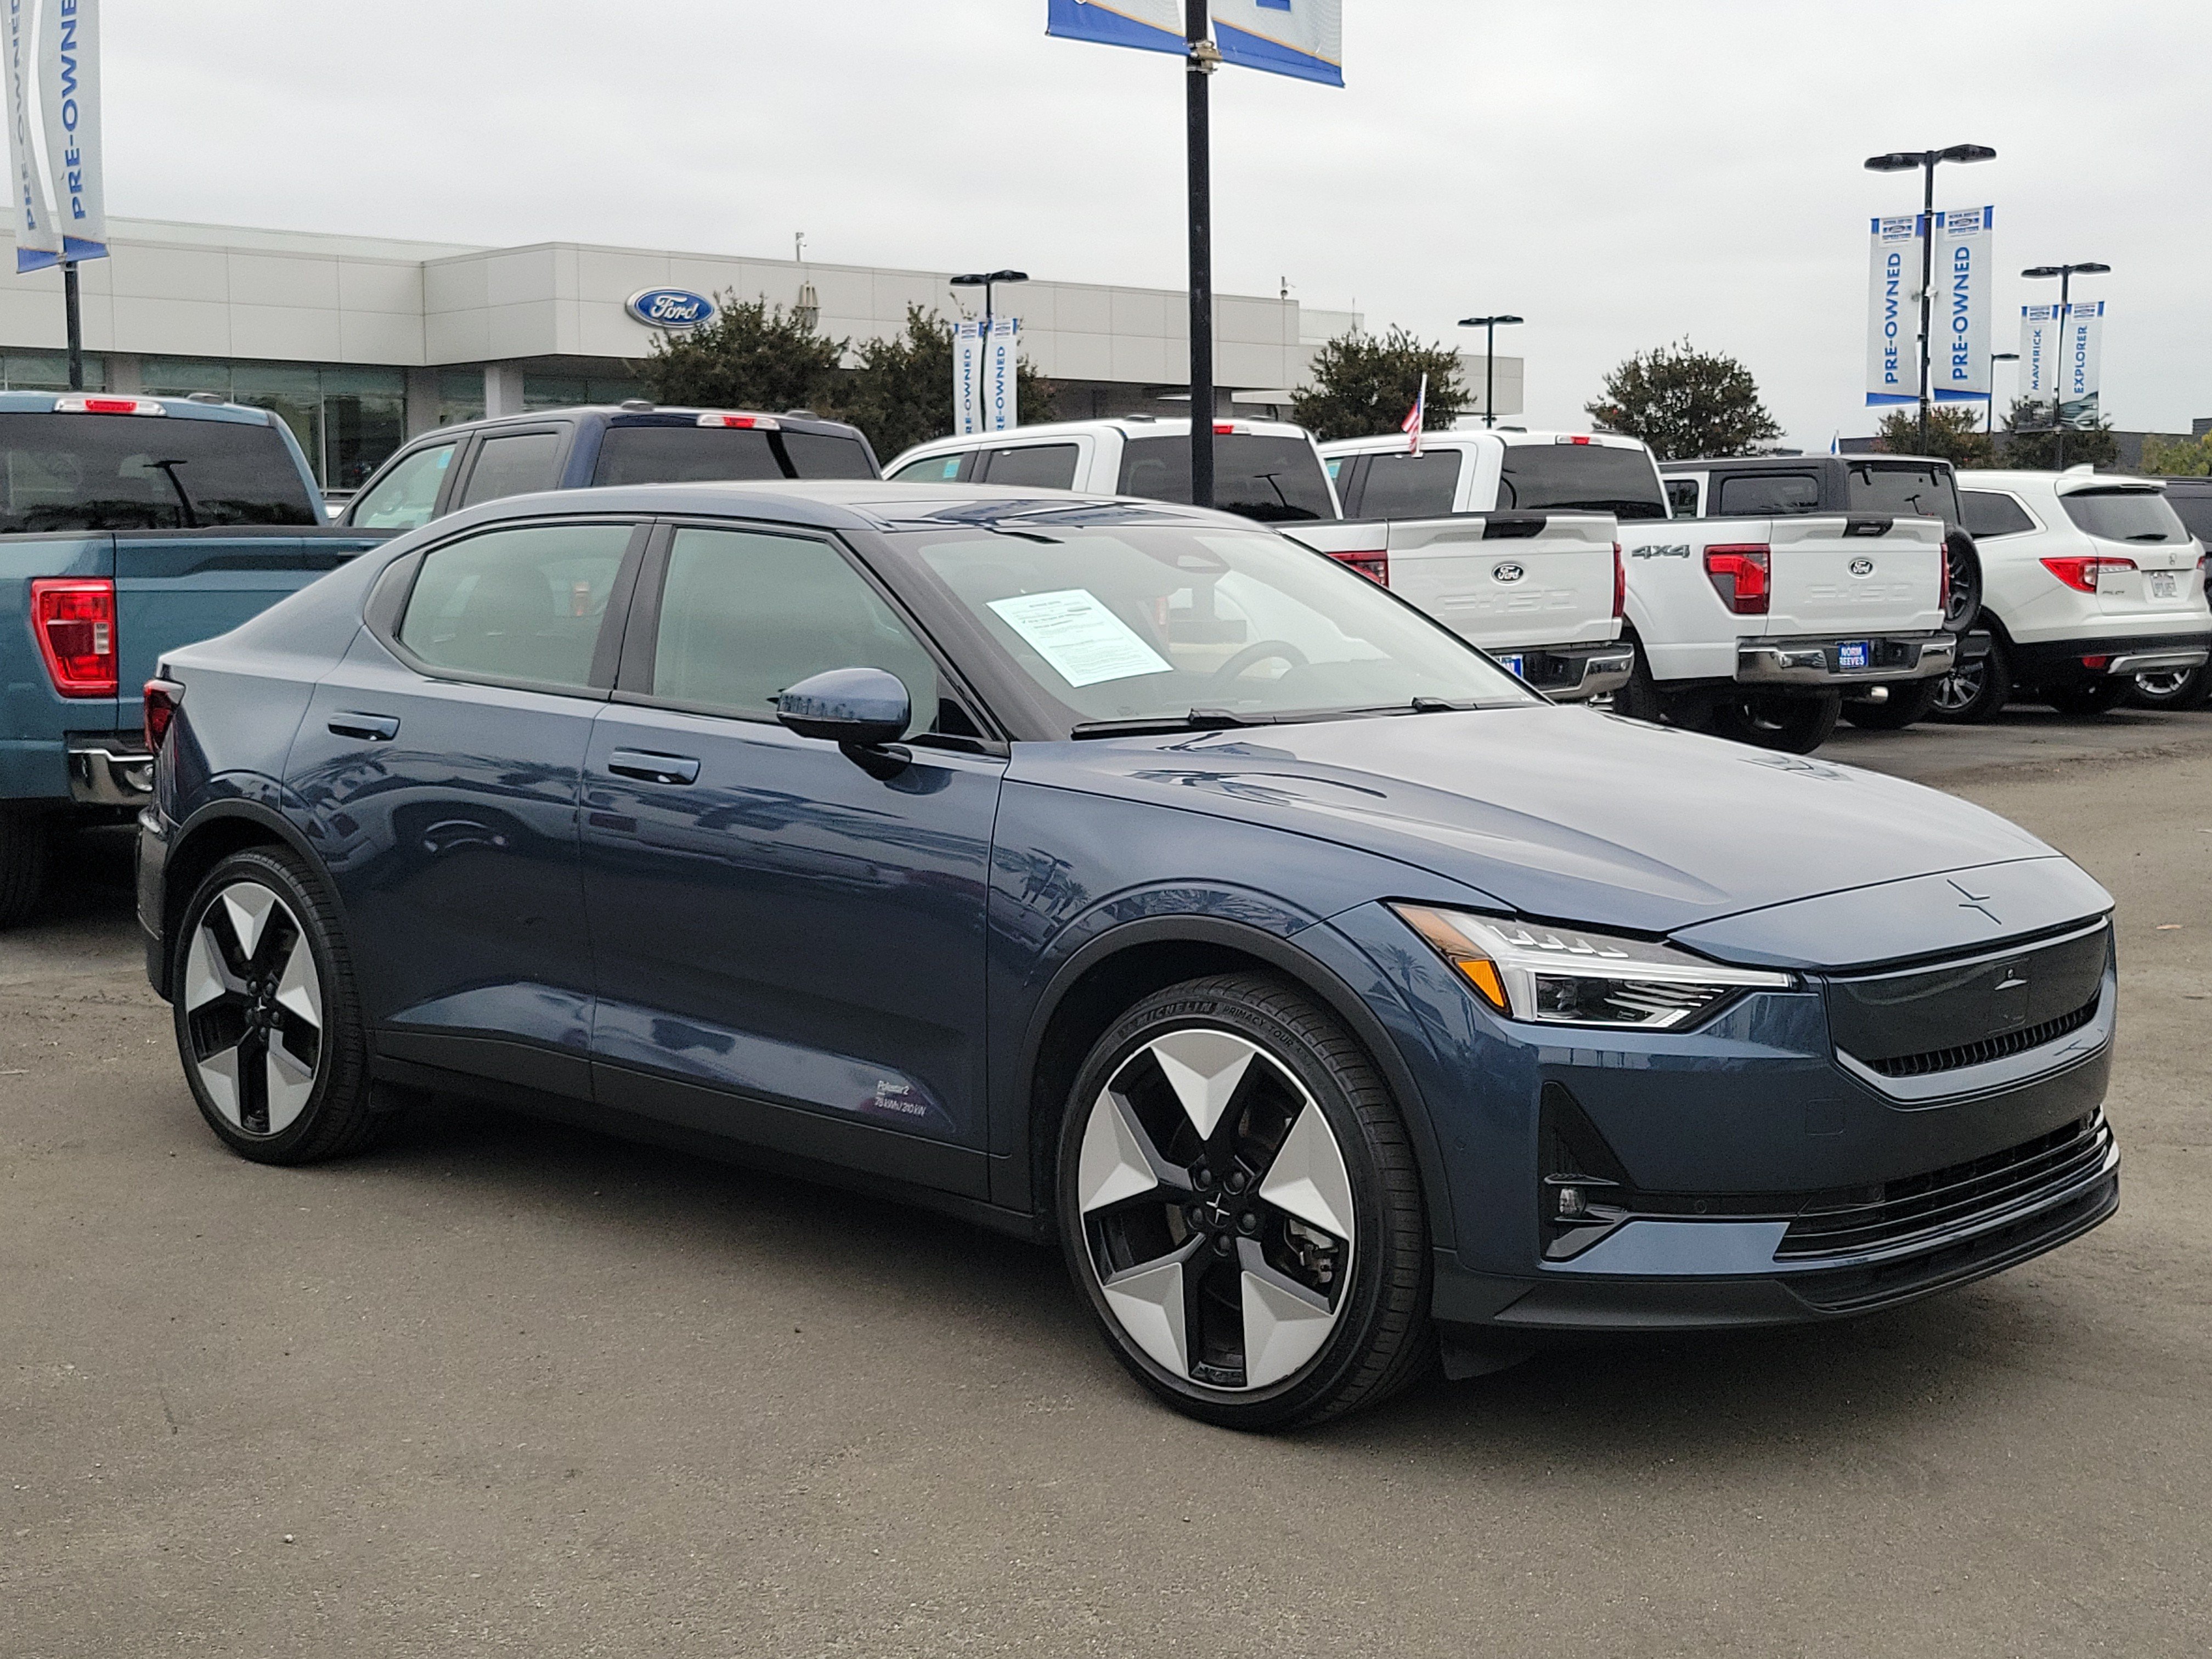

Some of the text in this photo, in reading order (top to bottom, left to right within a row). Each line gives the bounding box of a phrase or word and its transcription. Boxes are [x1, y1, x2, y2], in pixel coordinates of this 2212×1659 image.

[61, 0, 86, 220] PRE-OWNE
[650, 295, 699, 319] Ford
[1884, 253, 1901, 384] PRE-OWNED
[1953, 246, 1970, 380] PRE-OWNED
[2032, 329, 2041, 390] MAVERICK
[2074, 325, 2087, 393] EXPLORER
[964, 349, 972, 433] RE-OWNED
[996, 346, 1005, 431] RE-OWNED
[1497, 566, 1520, 580] Ford
[1804, 582, 1913, 603] F-150
[1434, 589, 1578, 617] F-150
[1839, 656, 1864, 665] REEVES
[1841, 646, 1862, 656] NORM
[1136, 1002, 1294, 1048] MICHELIN PRIMACY TOUR
